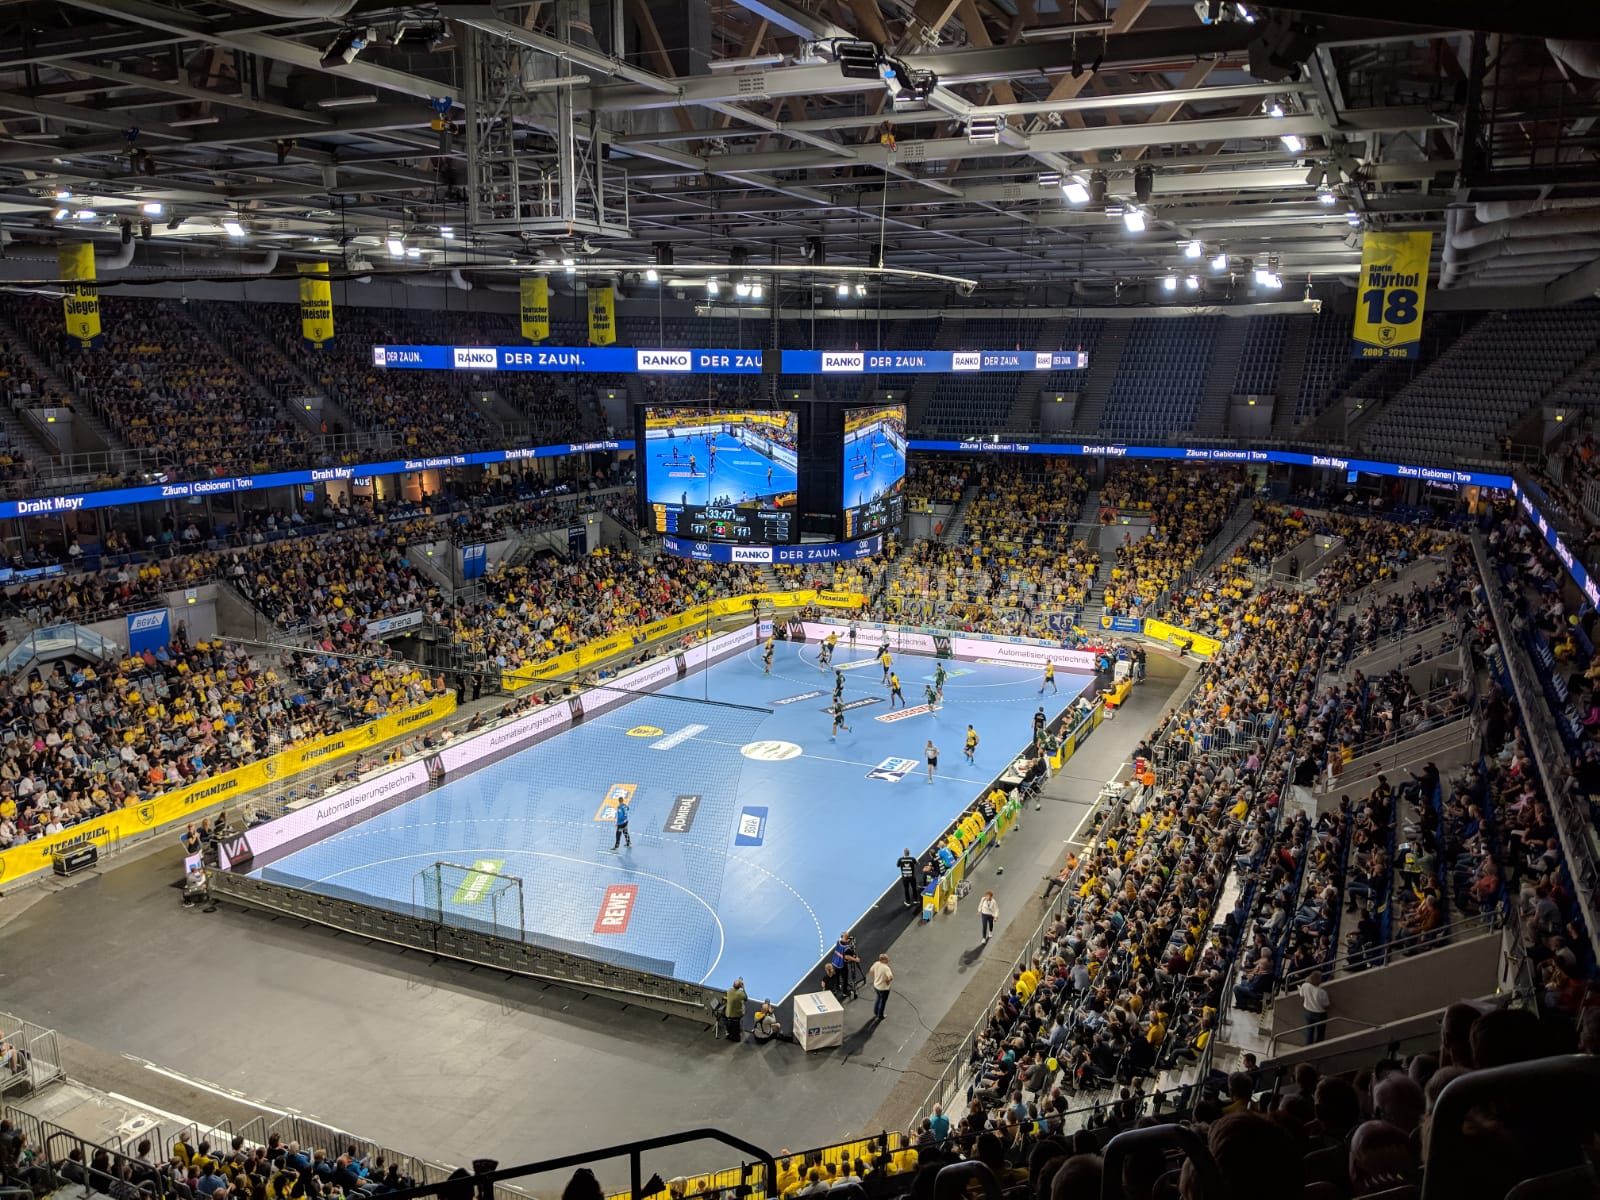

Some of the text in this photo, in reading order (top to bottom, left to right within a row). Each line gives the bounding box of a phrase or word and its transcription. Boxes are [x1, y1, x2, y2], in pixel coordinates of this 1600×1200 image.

[1368, 273, 1419, 288] Myrhol
[81, 284, 97, 297] Cup
[67, 299, 98, 315] Sieger
[1362, 289, 1419, 325] 18
[302, 308, 330, 320] Meister
[386, 351, 398, 362] DER
[399, 351, 423, 363] ZAUN.
[457, 352, 585, 365] RANKO DER ZAUN.
[642, 355, 688, 365] RANKO
[700, 355, 730, 367] DER
[826, 356, 926, 367] RANKO DER ZAUN.
[955, 356, 1020, 366] RANKO DER ZAUN.
[1082, 445, 1127, 456] Draht Mayr
[1185, 449, 1267, 459] Zäune Gabionen Tore
[1312, 456, 1349, 469] Draht Mayr
[312, 467, 355, 480] Draht Mayr
[1421, 468, 1452, 479] Gabionen
[1456, 471, 1471, 482] Tore
[162, 486, 188, 496] Zäune
[194, 481, 231, 492] Gabionen
[18, 497, 84, 514] Draht Mayr
[708, 509, 732, 519] 33:47
[735, 549, 840, 560] RANKO DER ZAUN.
[390, 617, 411, 629] arena
[997, 648, 1090, 665] Automatisierungstechnik
[881, 758, 903, 770] DKB
[315, 771, 417, 822] Automatisierungstechnik
[669, 795, 697, 832] ADMIRAL
[224, 836, 249, 859] VA
[601, 890, 631, 926] REWE
